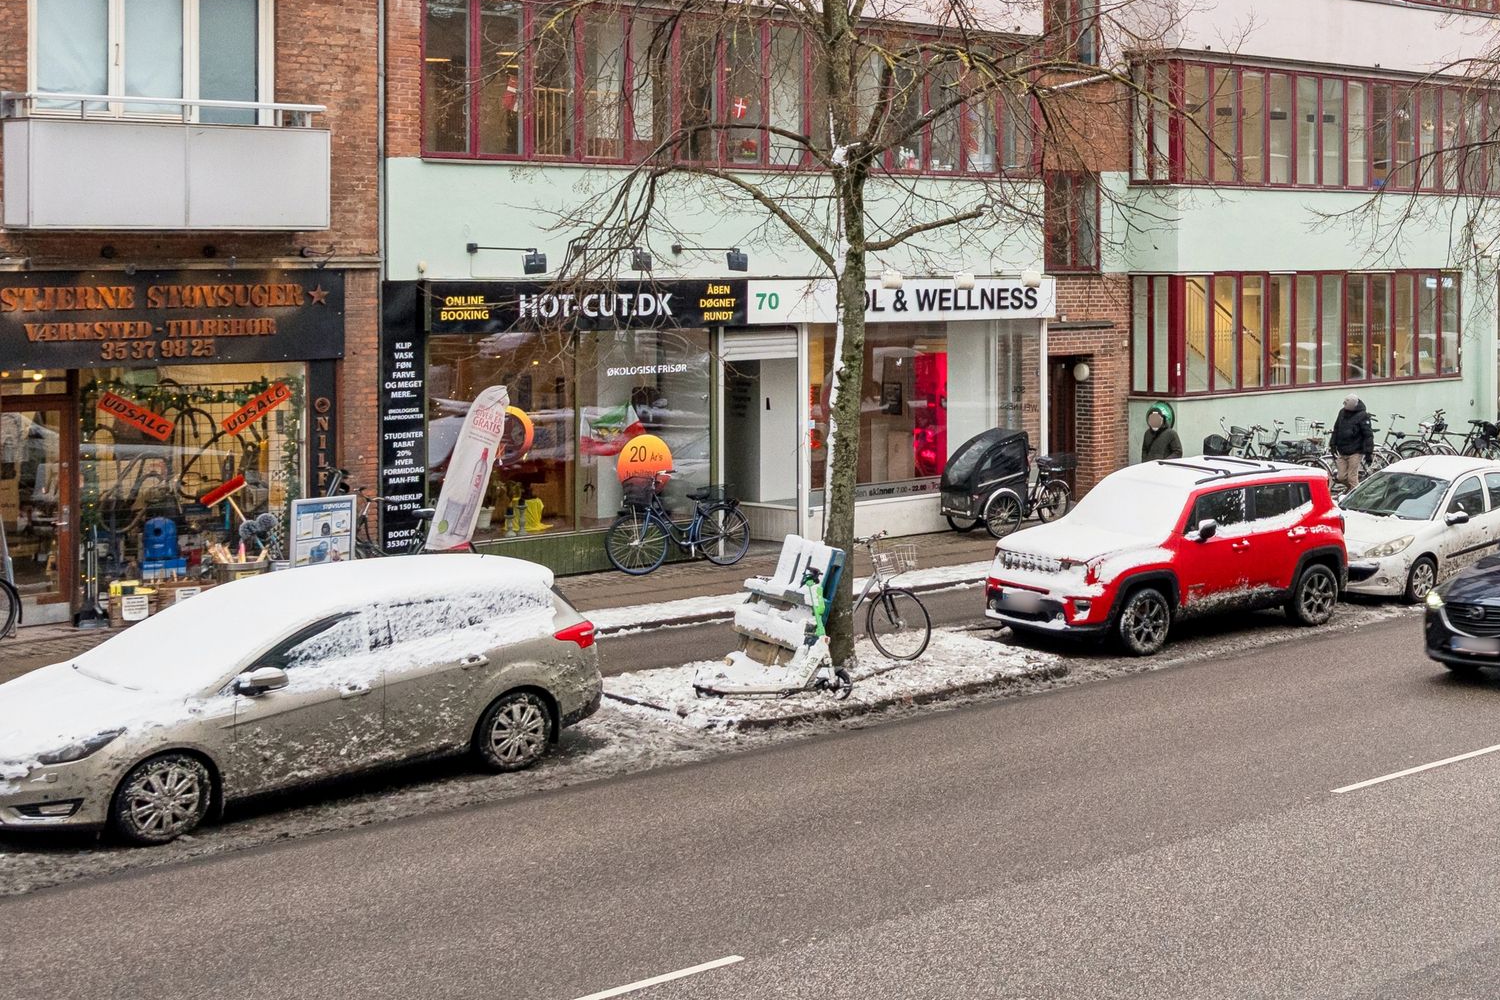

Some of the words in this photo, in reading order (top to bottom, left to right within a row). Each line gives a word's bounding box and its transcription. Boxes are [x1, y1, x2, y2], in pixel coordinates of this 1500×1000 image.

[707, 283, 731, 295] ÅBEN
[0, 285, 136, 312] STJERNE
[146, 283, 305, 309] STØVSUGER
[445, 296, 485, 306] ONLINE
[700, 298, 735, 308] DØGNET
[755, 292, 780, 311] 70
[892, 289, 908, 312] &
[915, 287, 1038, 312] WELLNESS
[519, 293, 673, 318] HOT-CUT.DK
[441, 310, 489, 321] BOOKING
[703, 311, 733, 321] RUNDT
[24, 321, 153, 342] VÆRKSTED
[101, 341, 129, 360] 35
[131, 341, 156, 360] 37
[161, 339, 188, 358] 98
[191, 338, 216, 357] 25
[392, 371, 415, 379] FARVE
[607, 365, 656, 376] ØKOLOGISK
[657, 364, 687, 373] FRISØR
[398, 380, 422, 388] MEGET
[226, 386, 285, 431] UDSALG
[103, 398, 169, 436] UDSALG
[472, 416, 501, 434] GRATIS
[384, 431, 424, 440] STUDENTER
[393, 440, 416, 448] RABAT
[629, 446, 647, 462] 20
[383, 466, 425, 476] FORMIDDAG
[388, 476, 420, 484] MAN-FRE
[388, 530, 410, 538] BOOK
